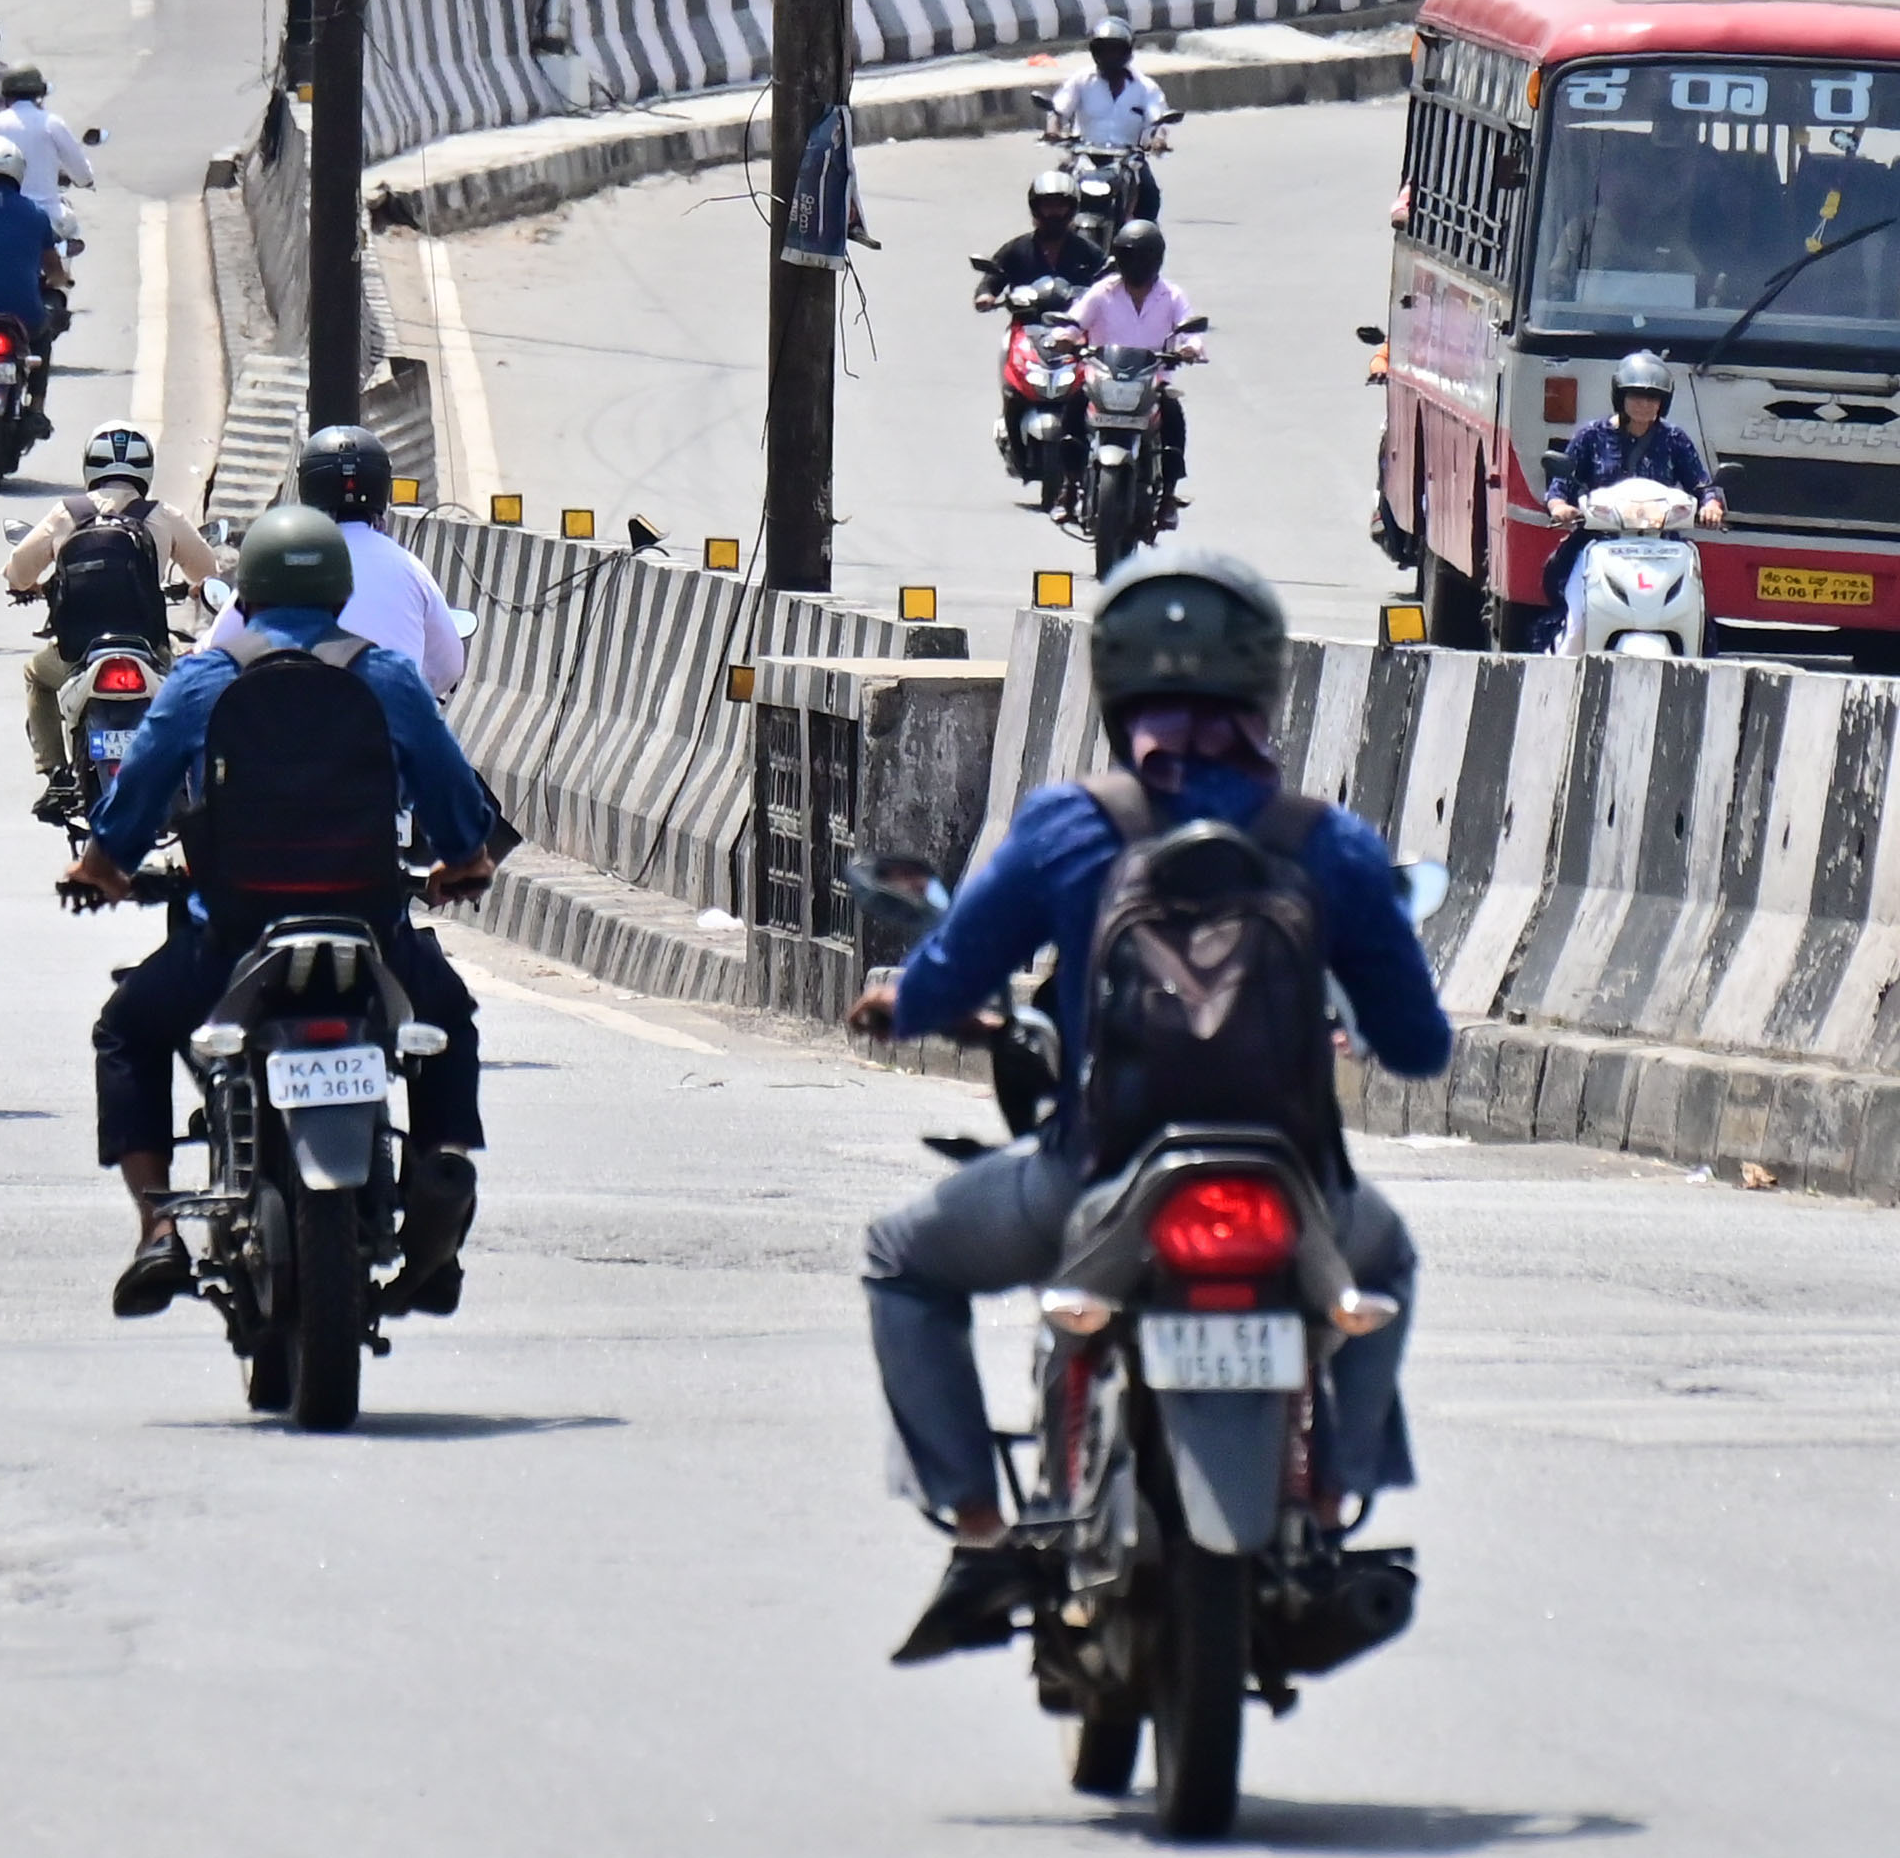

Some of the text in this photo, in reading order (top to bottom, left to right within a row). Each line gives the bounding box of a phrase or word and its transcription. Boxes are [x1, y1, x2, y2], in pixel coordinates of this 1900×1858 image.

[289, 1058, 363, 1078] KA 02
[278, 1078, 375, 1101] JM 3616
